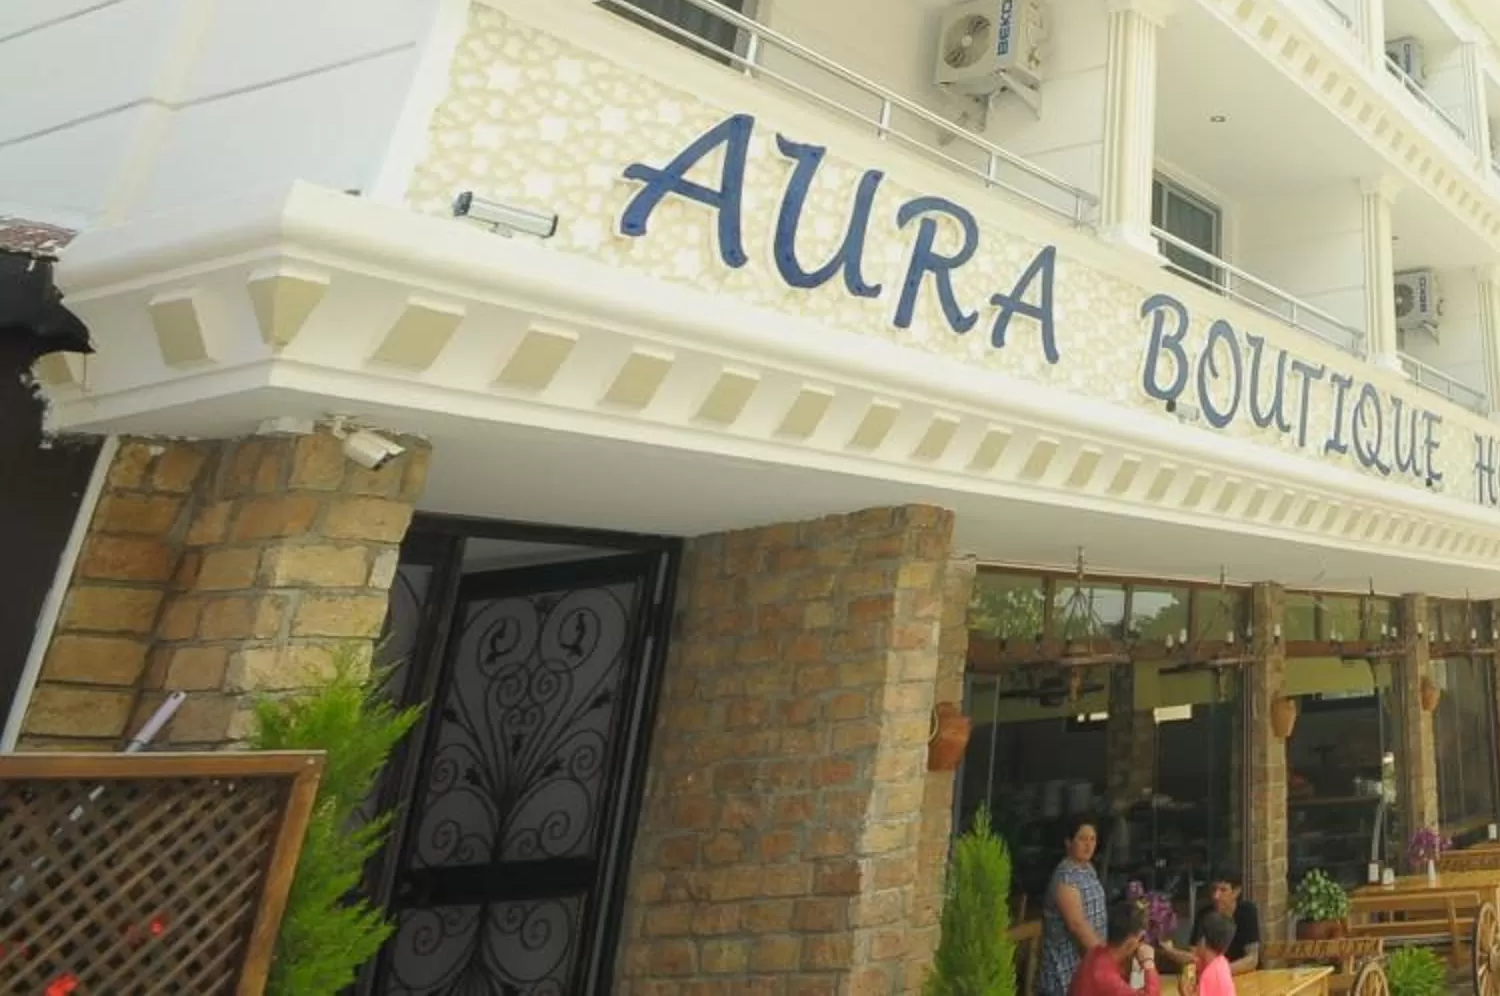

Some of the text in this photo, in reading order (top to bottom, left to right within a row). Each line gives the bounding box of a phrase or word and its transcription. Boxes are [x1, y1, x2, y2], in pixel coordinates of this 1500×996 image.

[997, 0, 1013, 56] BEKO
[619, 113, 1060, 365] AURA
[1140, 293, 1443, 482] BOUTIQUE
